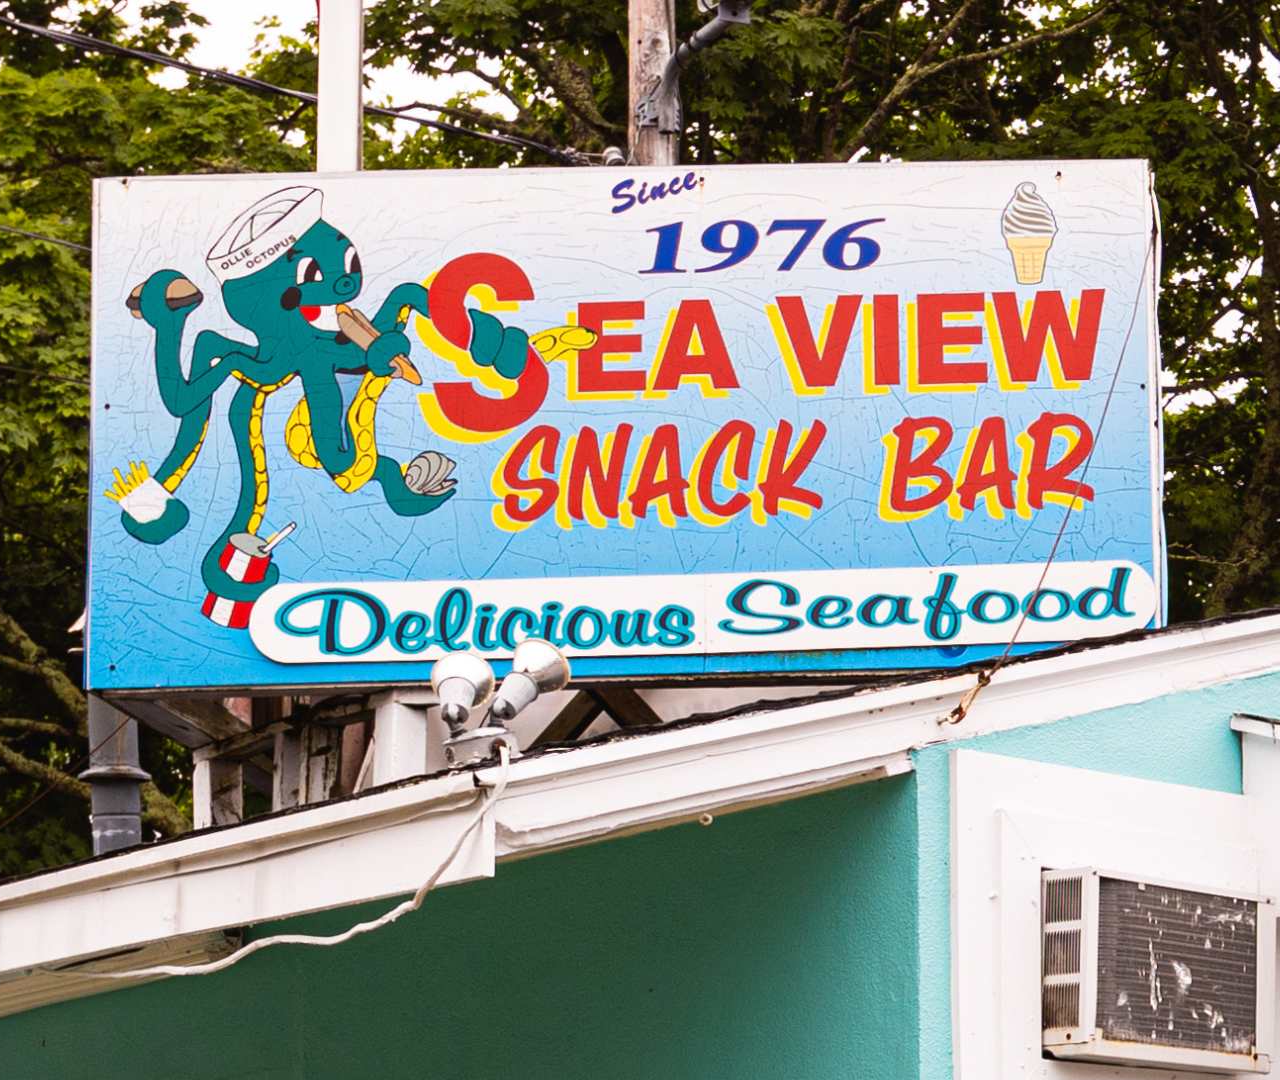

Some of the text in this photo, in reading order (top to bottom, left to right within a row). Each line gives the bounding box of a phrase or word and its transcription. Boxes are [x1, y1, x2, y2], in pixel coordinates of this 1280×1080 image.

[611, 171, 699, 214] Since
[220, 247, 254, 271] OLLIE
[245, 234, 297, 269] OCTOPUS
[638, 217, 886, 274] 1976
[420, 252, 1105, 440] SEA VIEW
[492, 413, 1095, 532] SNACK BAR
[274, 567, 1137, 656] Delicious Seafood
